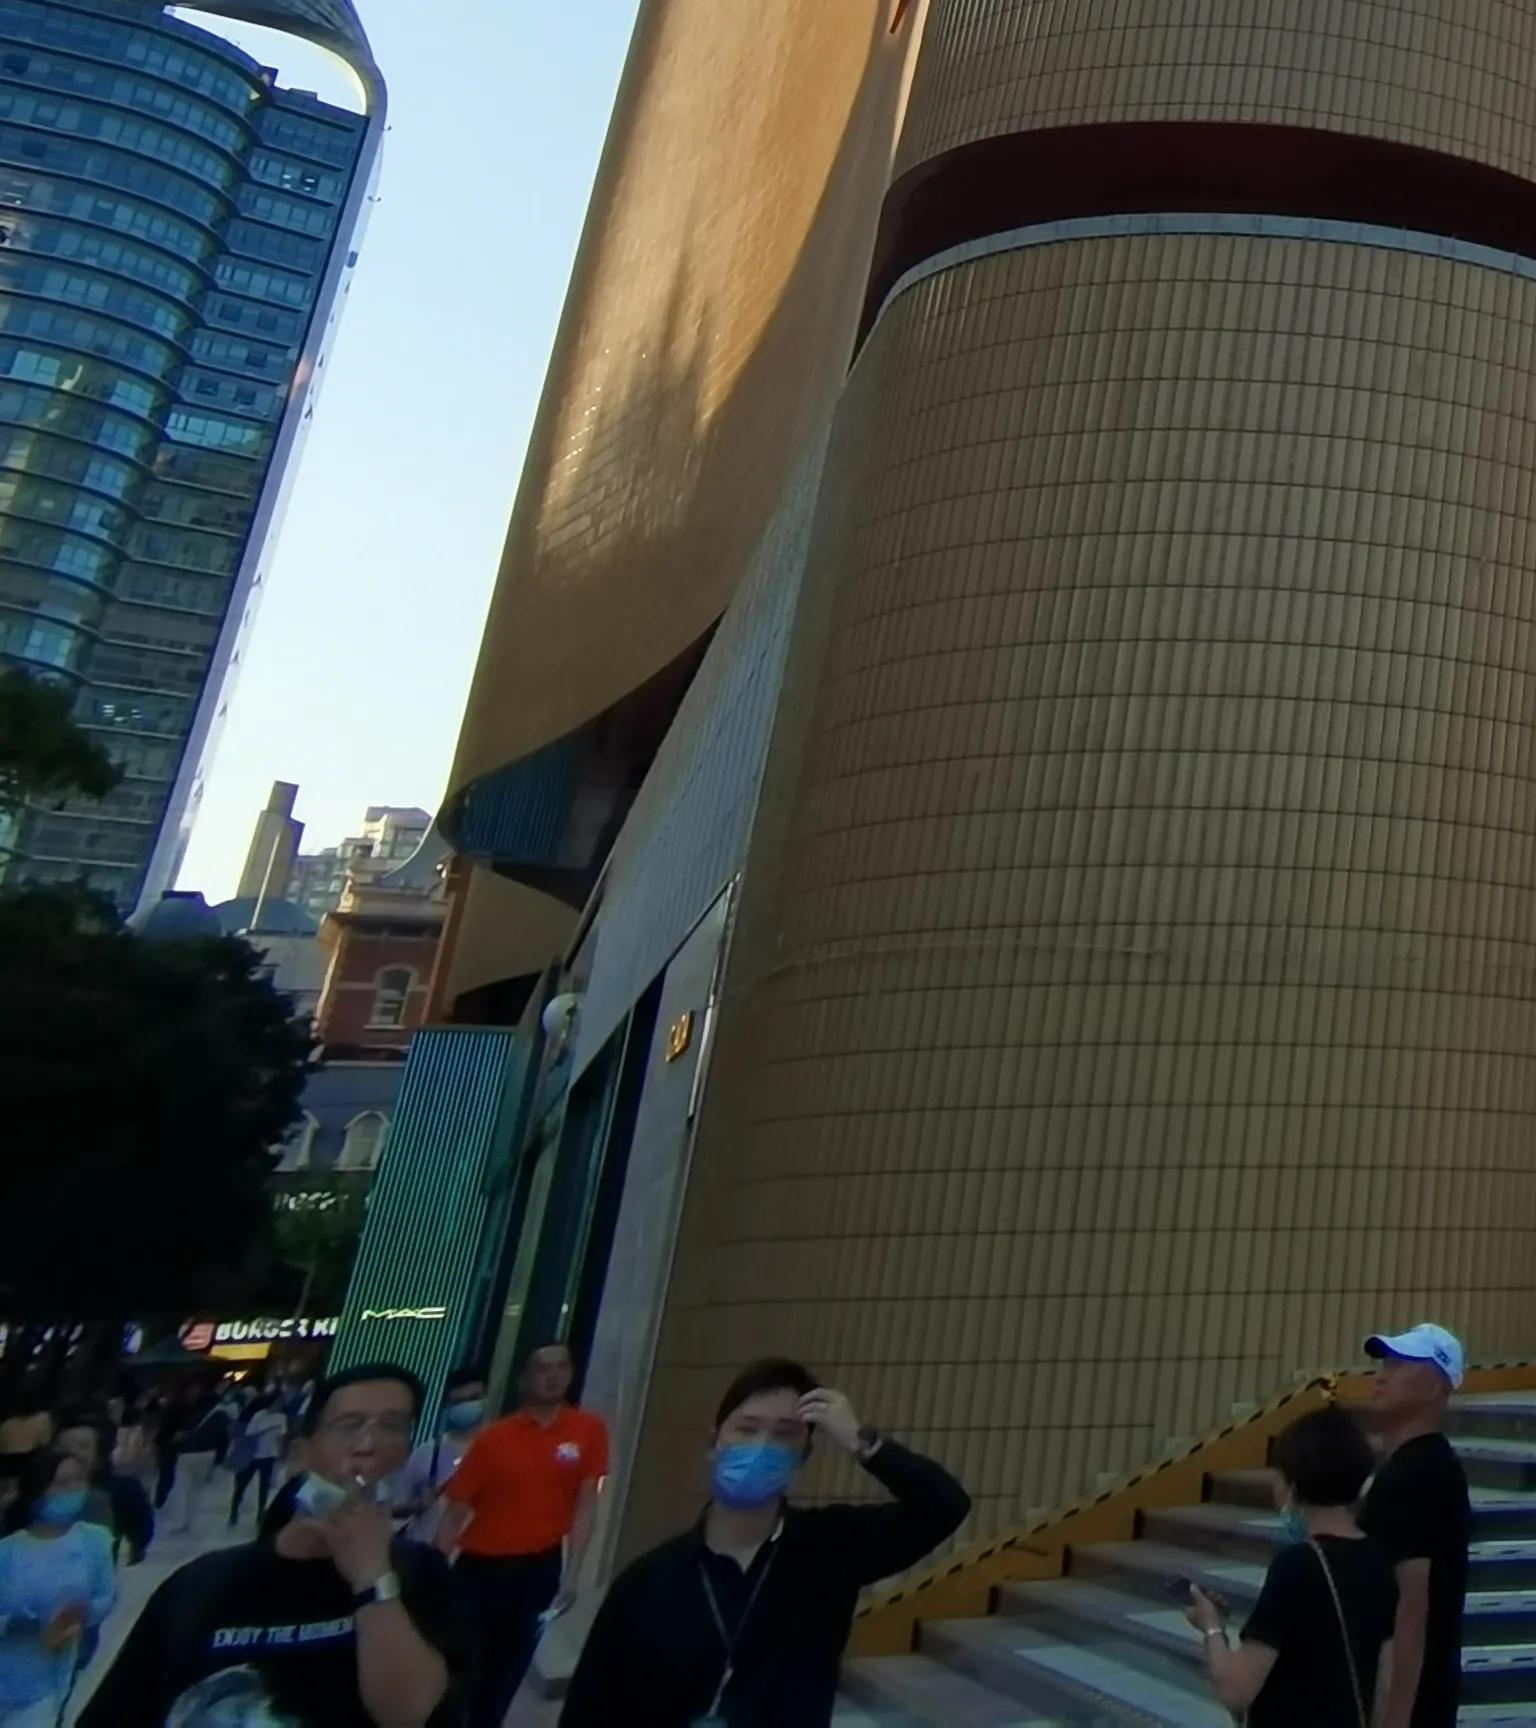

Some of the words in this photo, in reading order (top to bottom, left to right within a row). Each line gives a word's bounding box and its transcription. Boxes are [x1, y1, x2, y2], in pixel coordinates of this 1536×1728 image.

[311, 1315, 340, 1338] KI
[211, 1625, 264, 1649] ENJOY
[266, 1624, 298, 1645] THE
